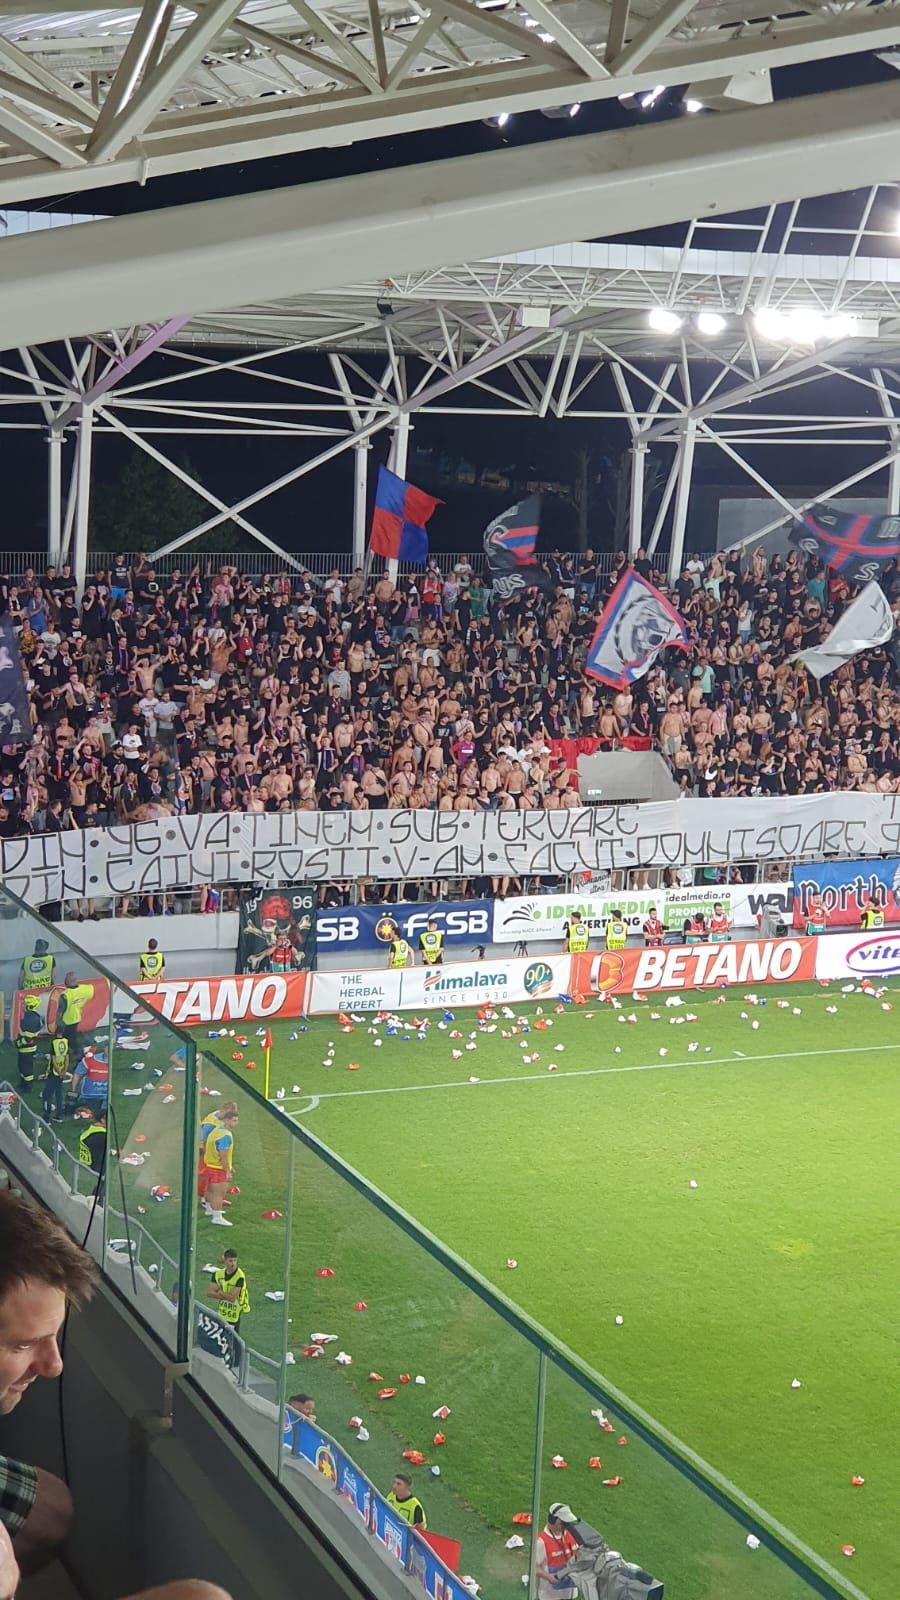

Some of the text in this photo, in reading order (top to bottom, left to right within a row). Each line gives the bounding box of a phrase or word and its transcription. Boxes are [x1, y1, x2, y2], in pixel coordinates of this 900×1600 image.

[2, 829, 86, 874] DIN
[177, 813, 230, 850] VA
[390, 810, 460, 844] SUB
[504, 838, 624, 874] FACUT
[292, 896, 313, 909] 96
[665, 891, 731, 903] idealmedia.ro
[546, 900, 656, 920] IDEAL MEDIA
[633, 940, 803, 990] BETANO
[341, 974, 363, 985] THE
[424, 970, 508, 992] Himalaya
[339, 986, 385, 998] HERBAL
[424, 991, 508, 1005] SINCE 1930
[338, 999, 383, 1011] EXPERT
